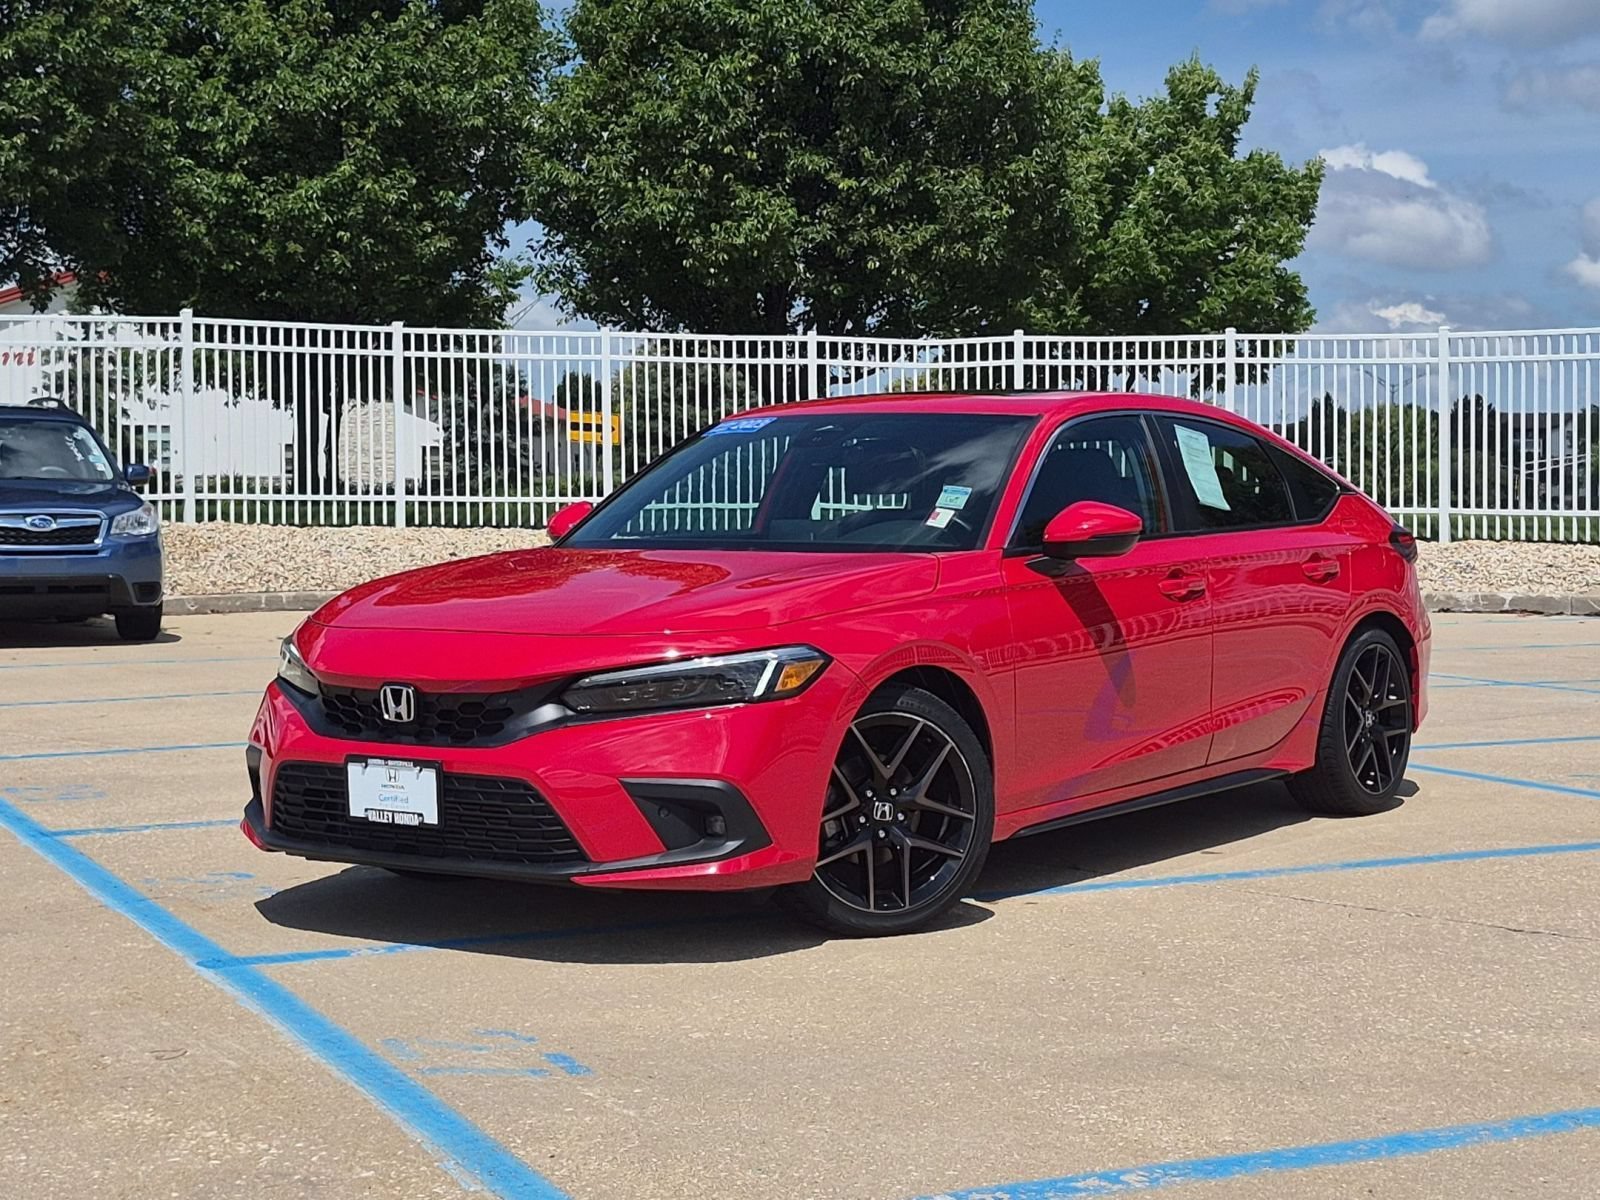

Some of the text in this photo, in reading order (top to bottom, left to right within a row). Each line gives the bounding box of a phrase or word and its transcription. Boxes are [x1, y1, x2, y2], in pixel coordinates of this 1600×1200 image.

[378, 794, 409, 804] Certified
[367, 809, 420, 826] VALLEY HONDA
